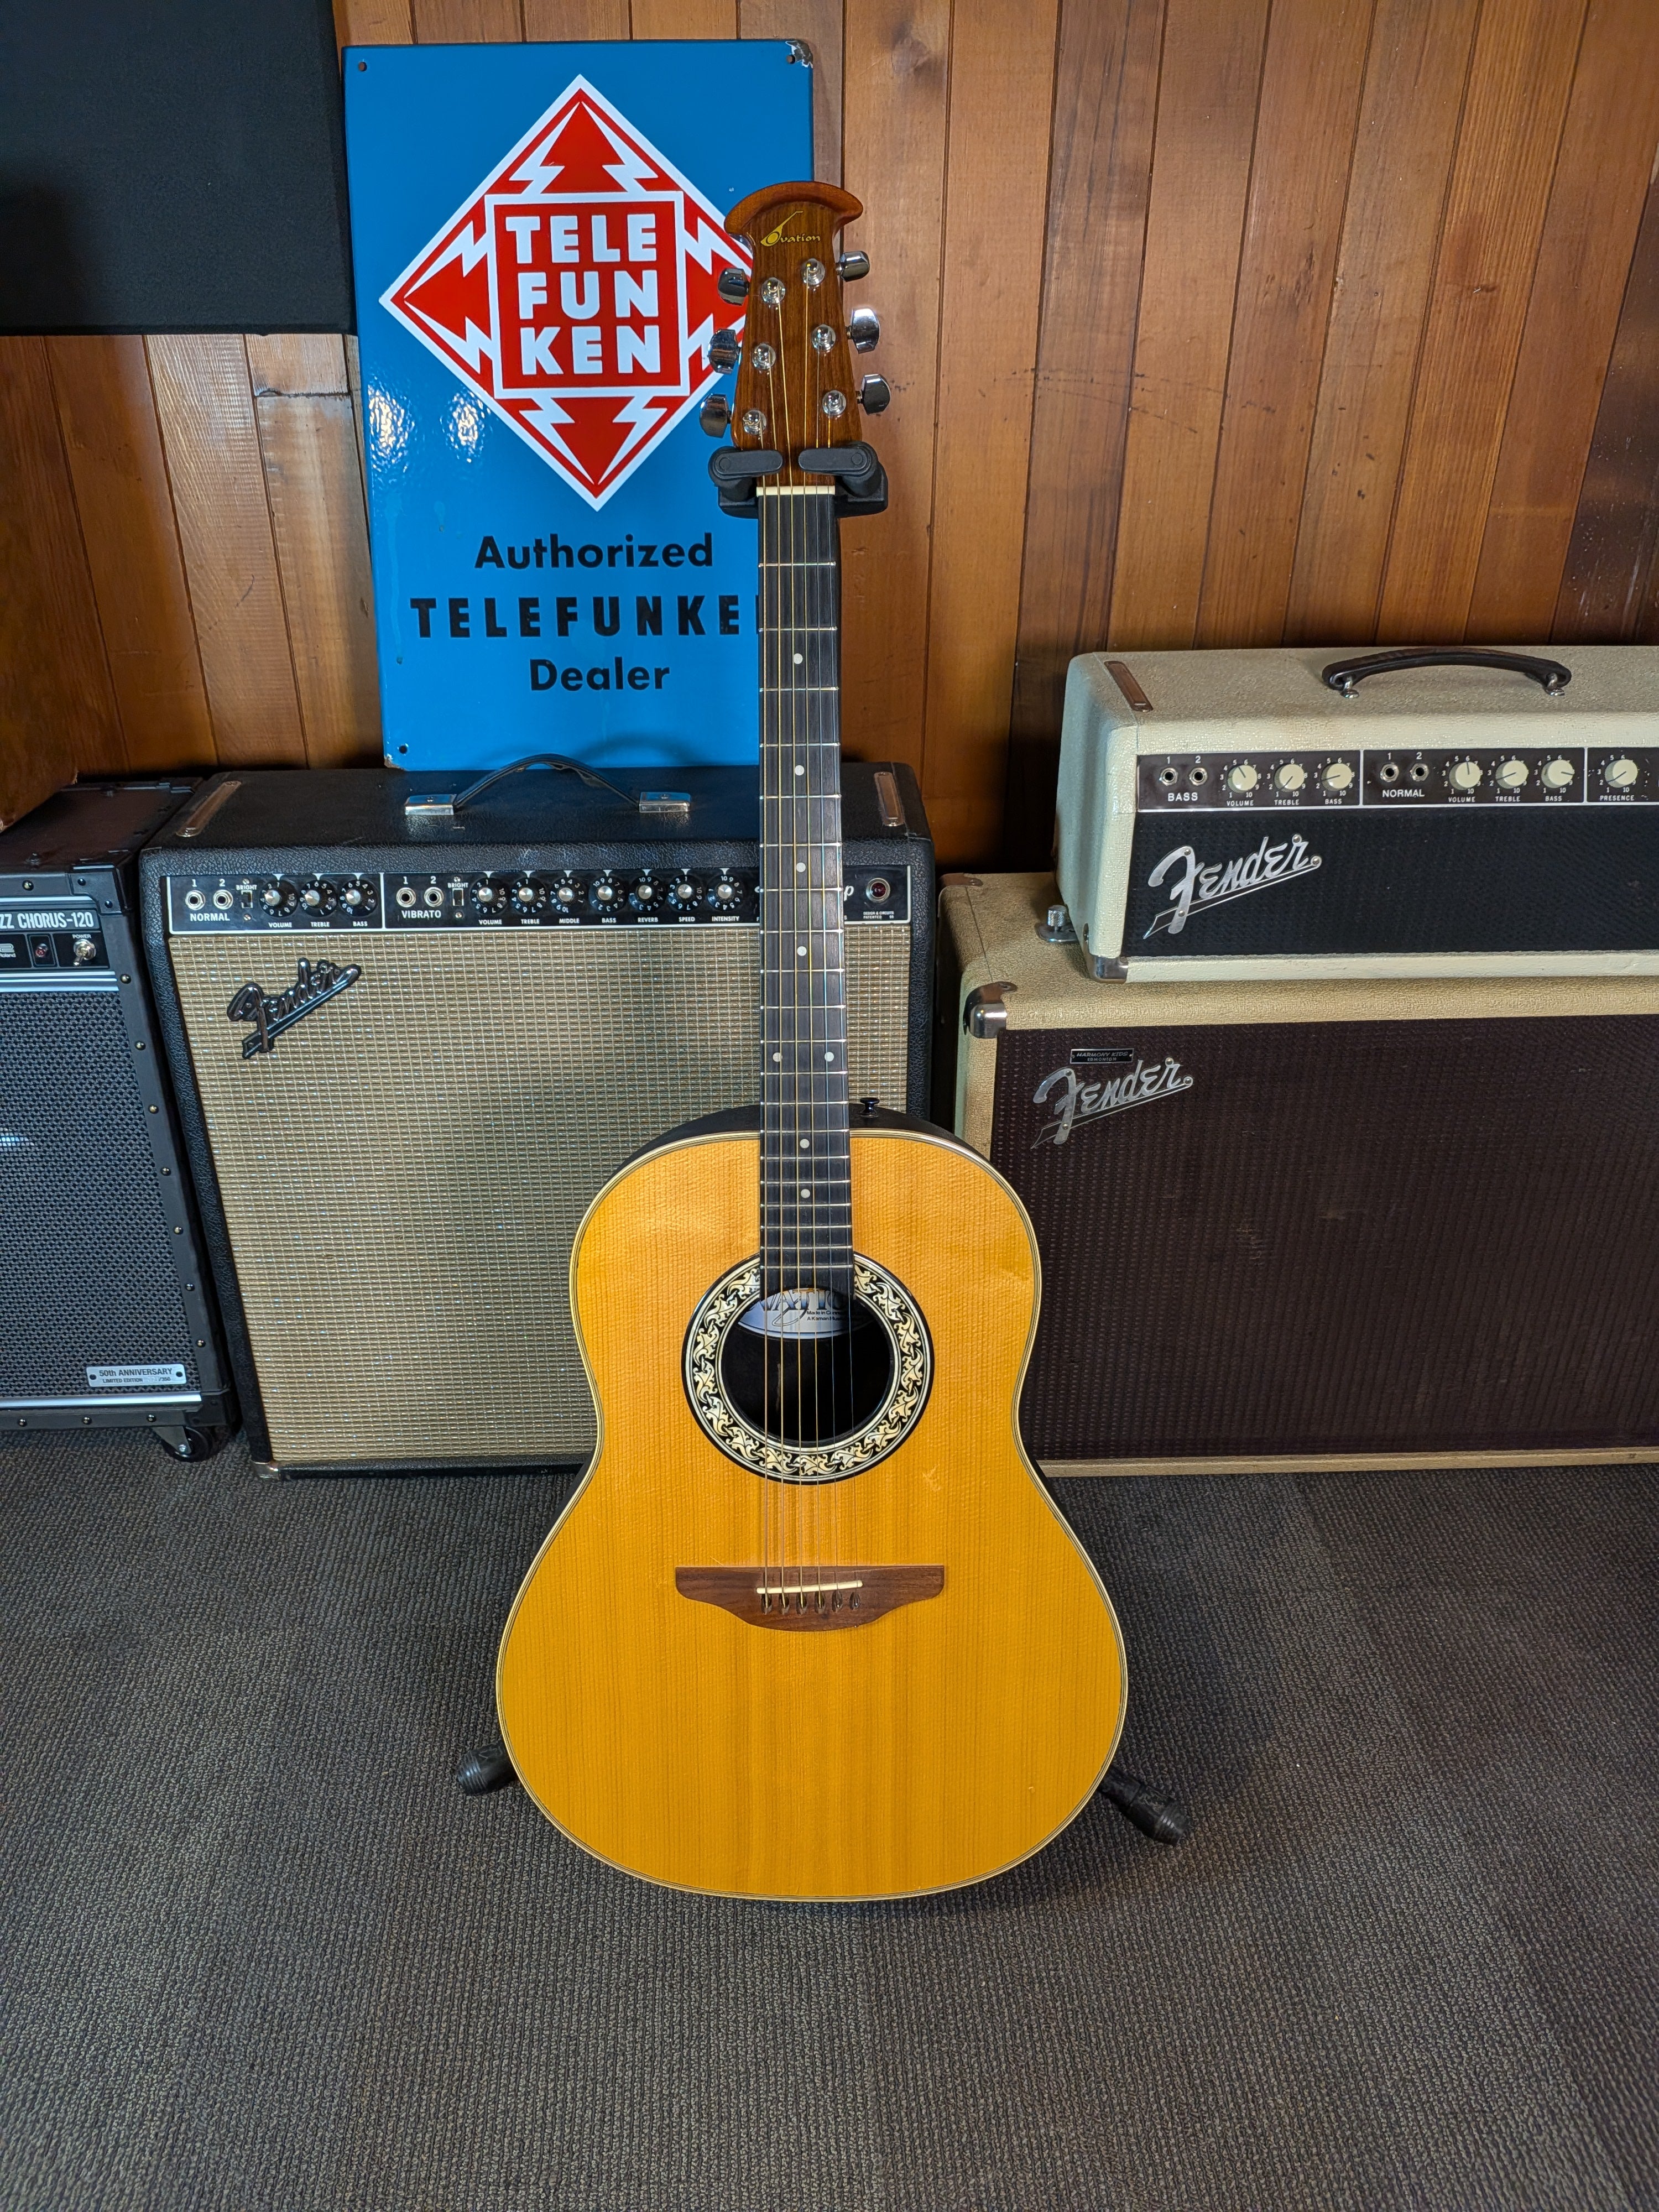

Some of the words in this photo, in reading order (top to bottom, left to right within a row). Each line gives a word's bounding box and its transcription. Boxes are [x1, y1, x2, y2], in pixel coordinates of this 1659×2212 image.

[505, 213, 656, 264] TELE
[760, 218, 821, 246] Ovation
[518, 270, 658, 319] FUN
[521, 325, 661, 374] KEN
[475, 532, 712, 569] Authorized
[410, 594, 758, 638] TELEFUNKE
[530, 656, 670, 691] Dealer
[1167, 792, 1198, 802] BASS
[1383, 789, 1425, 798] NORMAL
[1142, 834, 1322, 939] Fender
[17, 912, 94, 928] CHORUS-120
[190, 913, 230, 921] NORMAL
[401, 910, 441, 919] VIBRATO
[227, 957, 362, 1059] Fender
[1030, 1056, 1193, 1149] Fender
[119, 1368, 173, 1376] ANNIVERSARY
